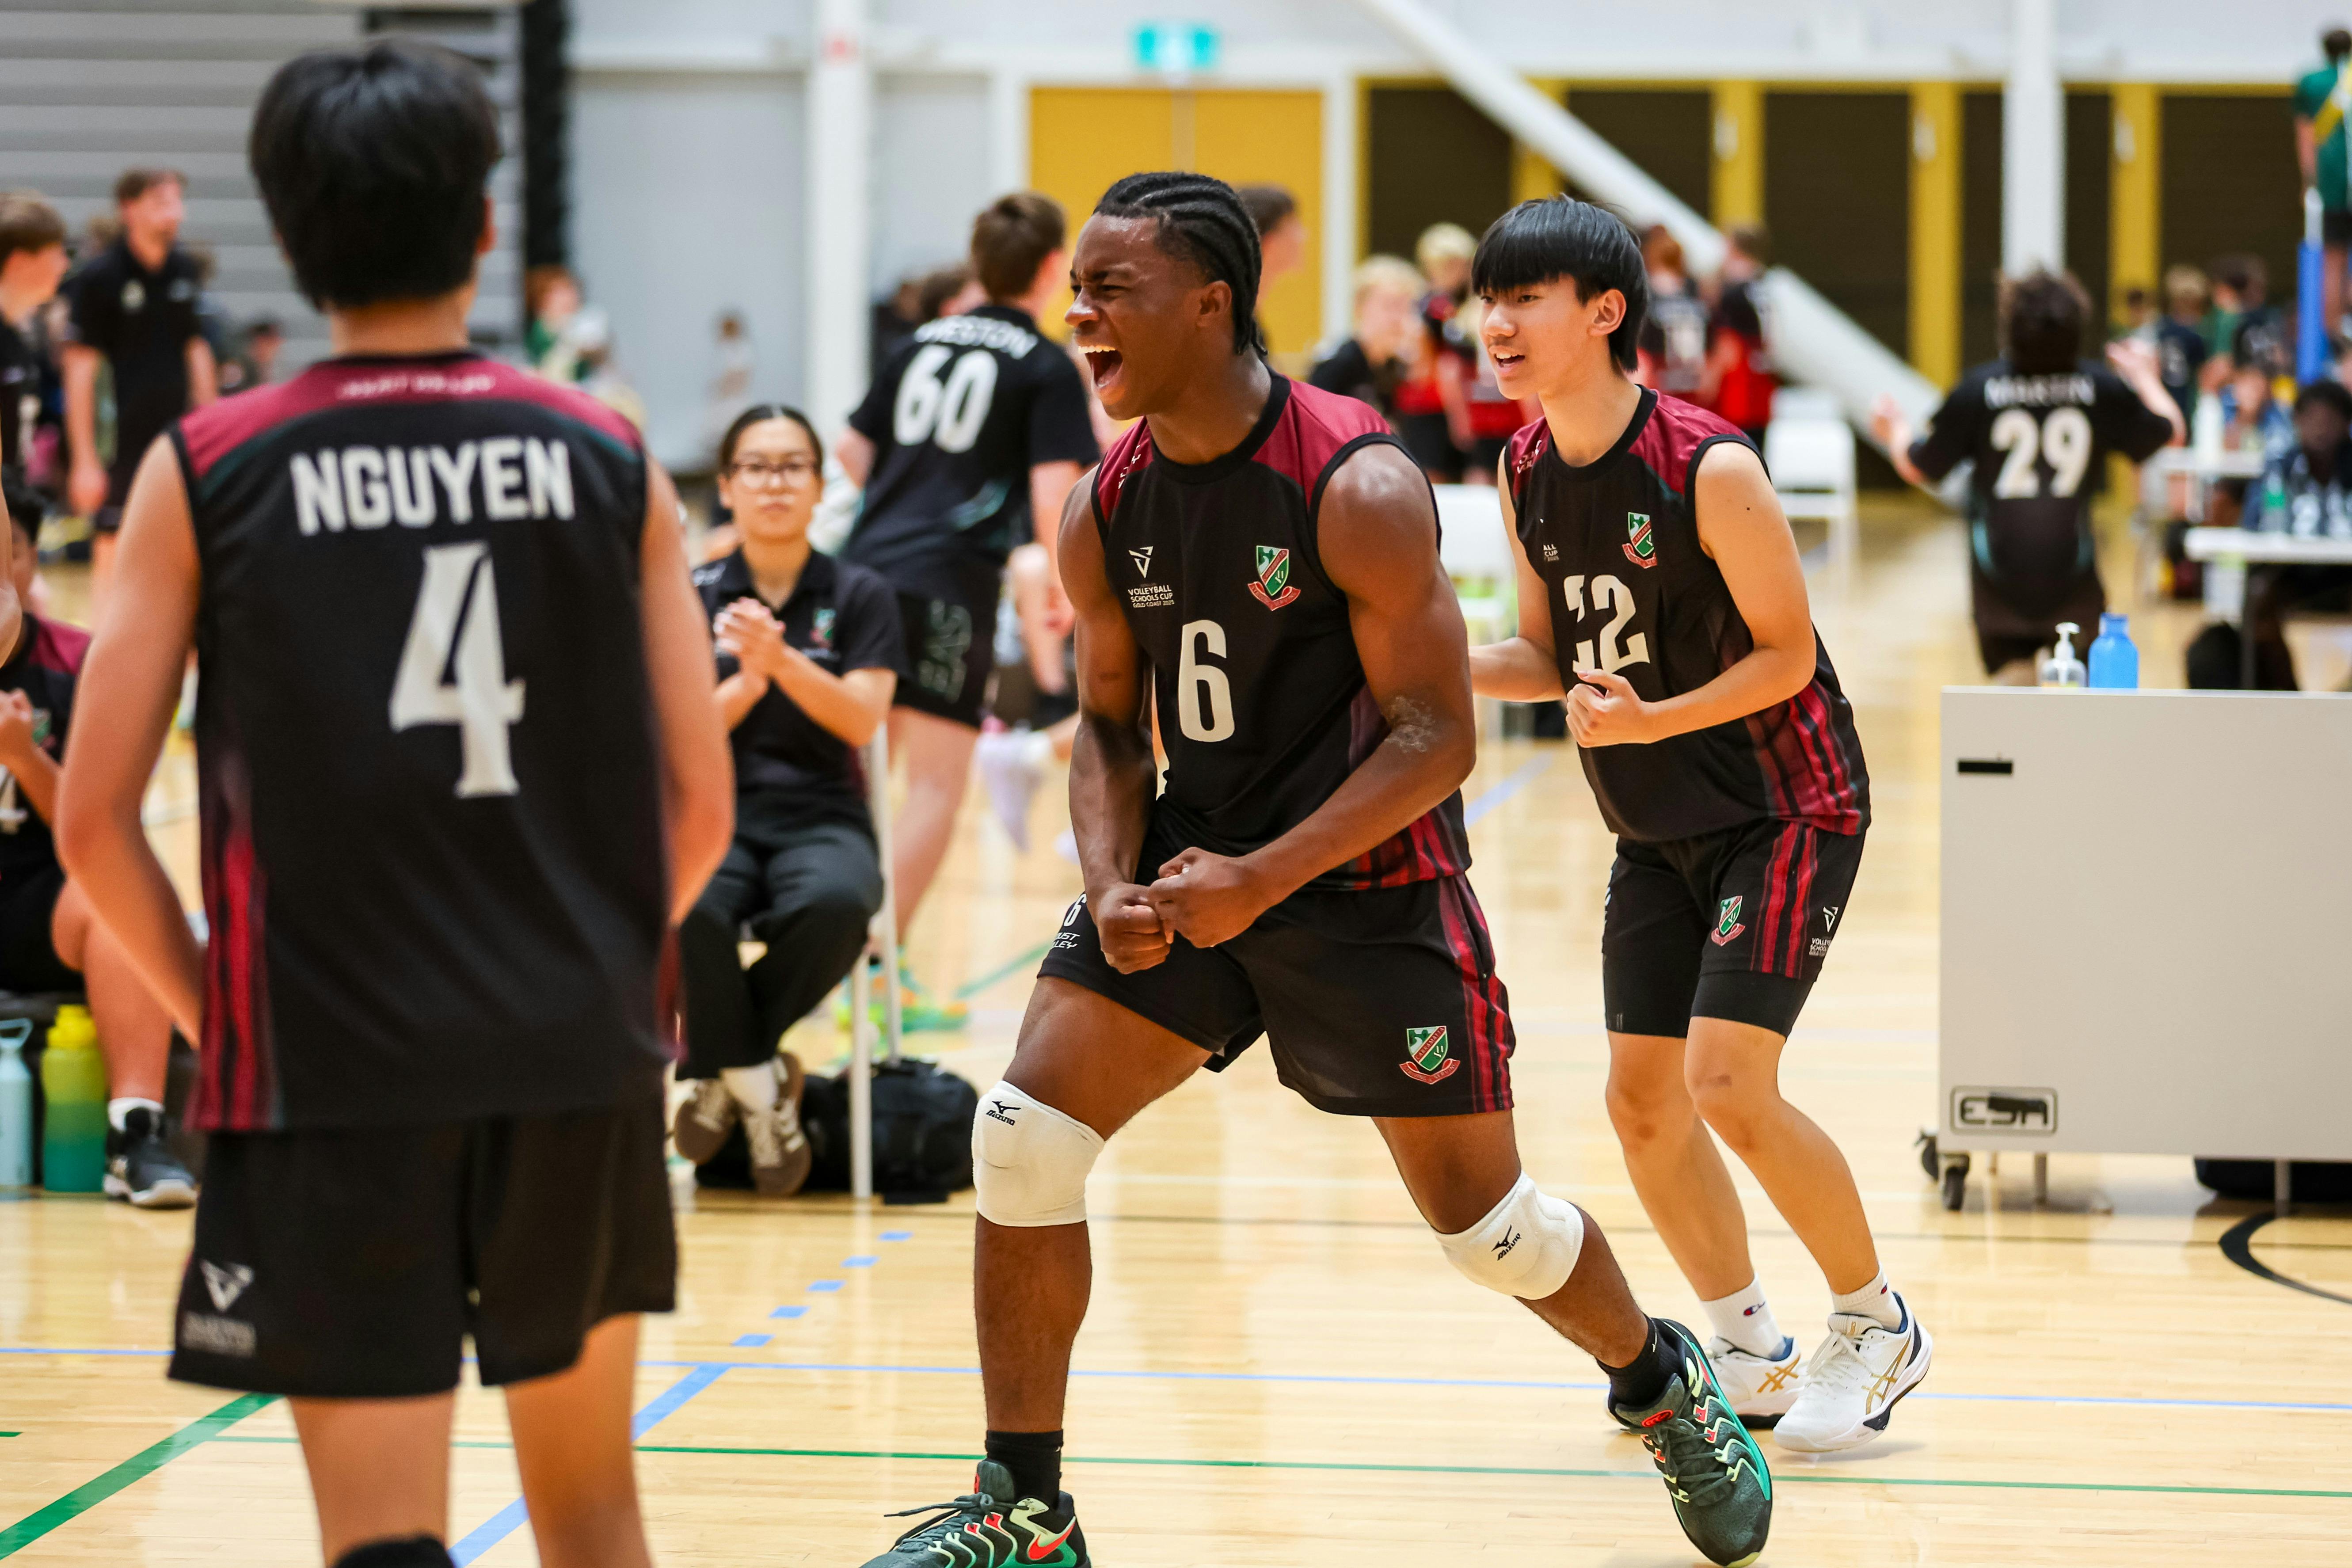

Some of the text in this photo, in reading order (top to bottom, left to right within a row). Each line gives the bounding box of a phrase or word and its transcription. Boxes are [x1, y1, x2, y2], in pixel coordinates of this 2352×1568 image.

[894, 344, 999, 453] 60
[289, 436, 576, 536] NGUYEN
[1991, 407, 2092, 499] 29
[1128, 585, 1172, 596] VOLLEYBALL
[1130, 594, 1159, 603] SCHOOLS
[388, 539, 526, 798] 4
[1178, 620, 1235, 742] 6
[1063, 893, 1087, 927] 6
